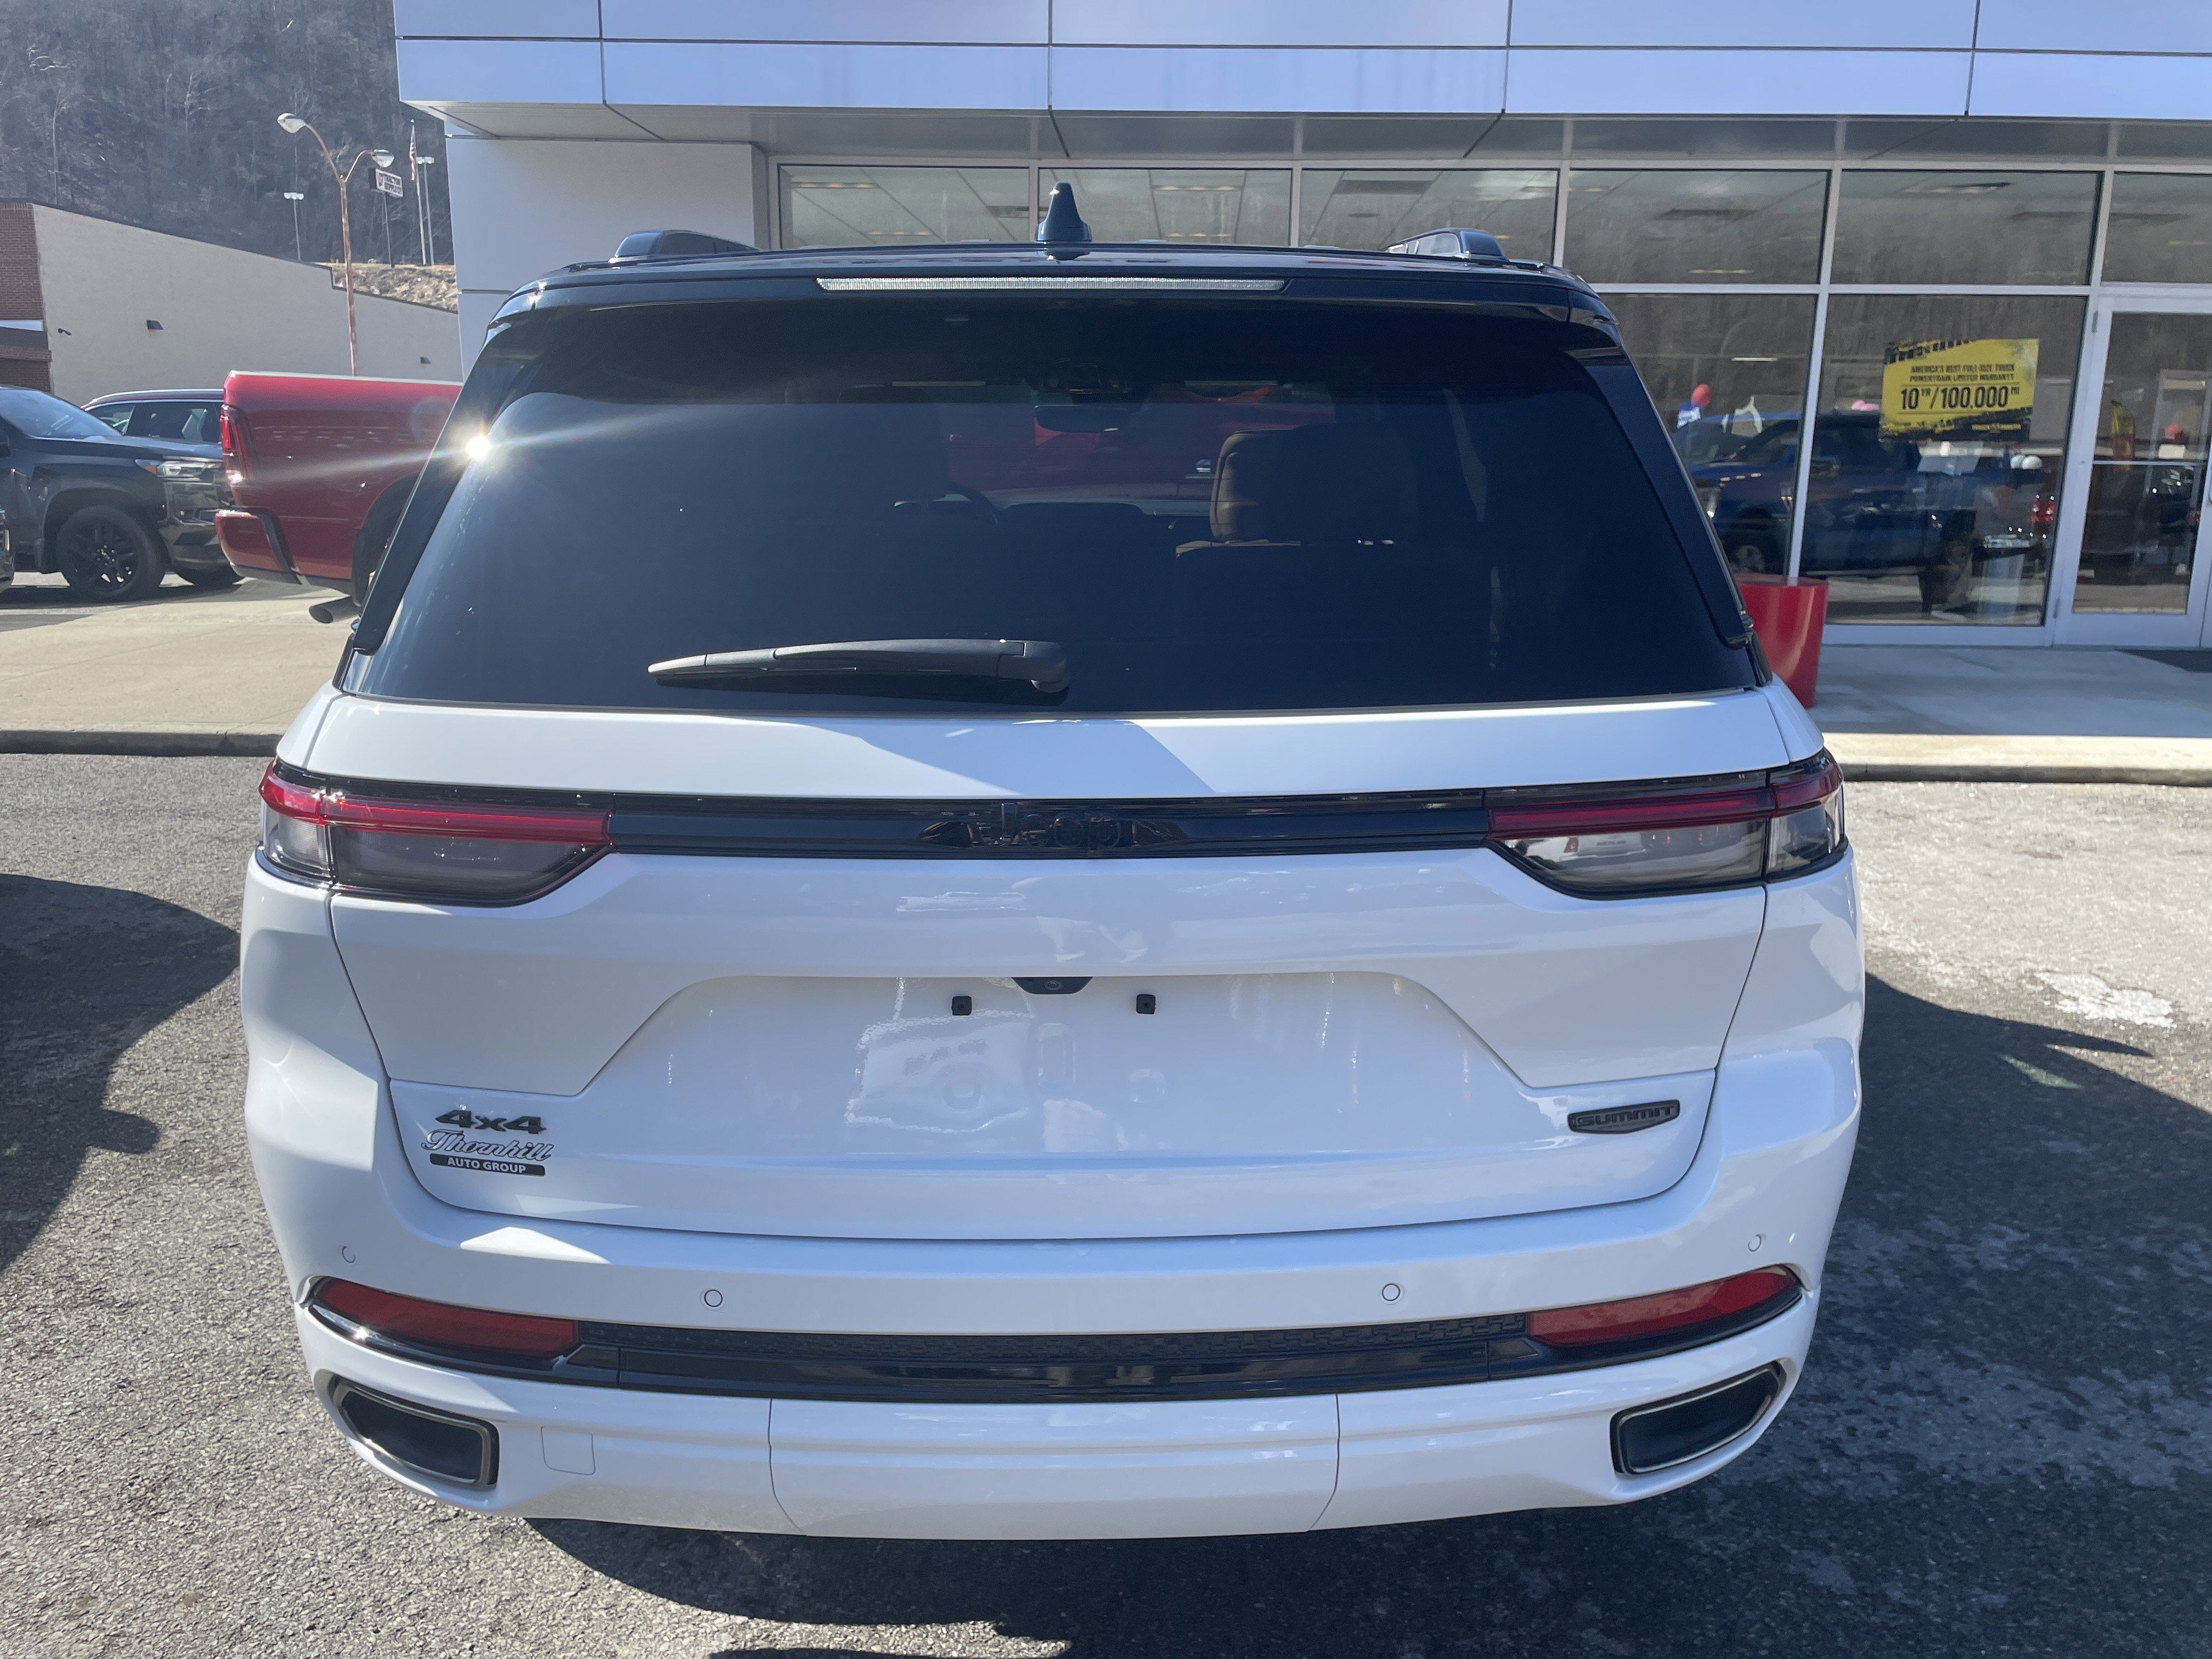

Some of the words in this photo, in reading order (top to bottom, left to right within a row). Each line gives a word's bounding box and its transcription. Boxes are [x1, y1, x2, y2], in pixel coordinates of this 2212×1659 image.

[435, 1110, 546, 1134] 4x4
[1577, 1105, 1674, 1127] SUMMIT
[421, 1128, 554, 1161] Thornhill
[447, 1157, 480, 1170] AUTO
[483, 1161, 526, 1173] GROUP
